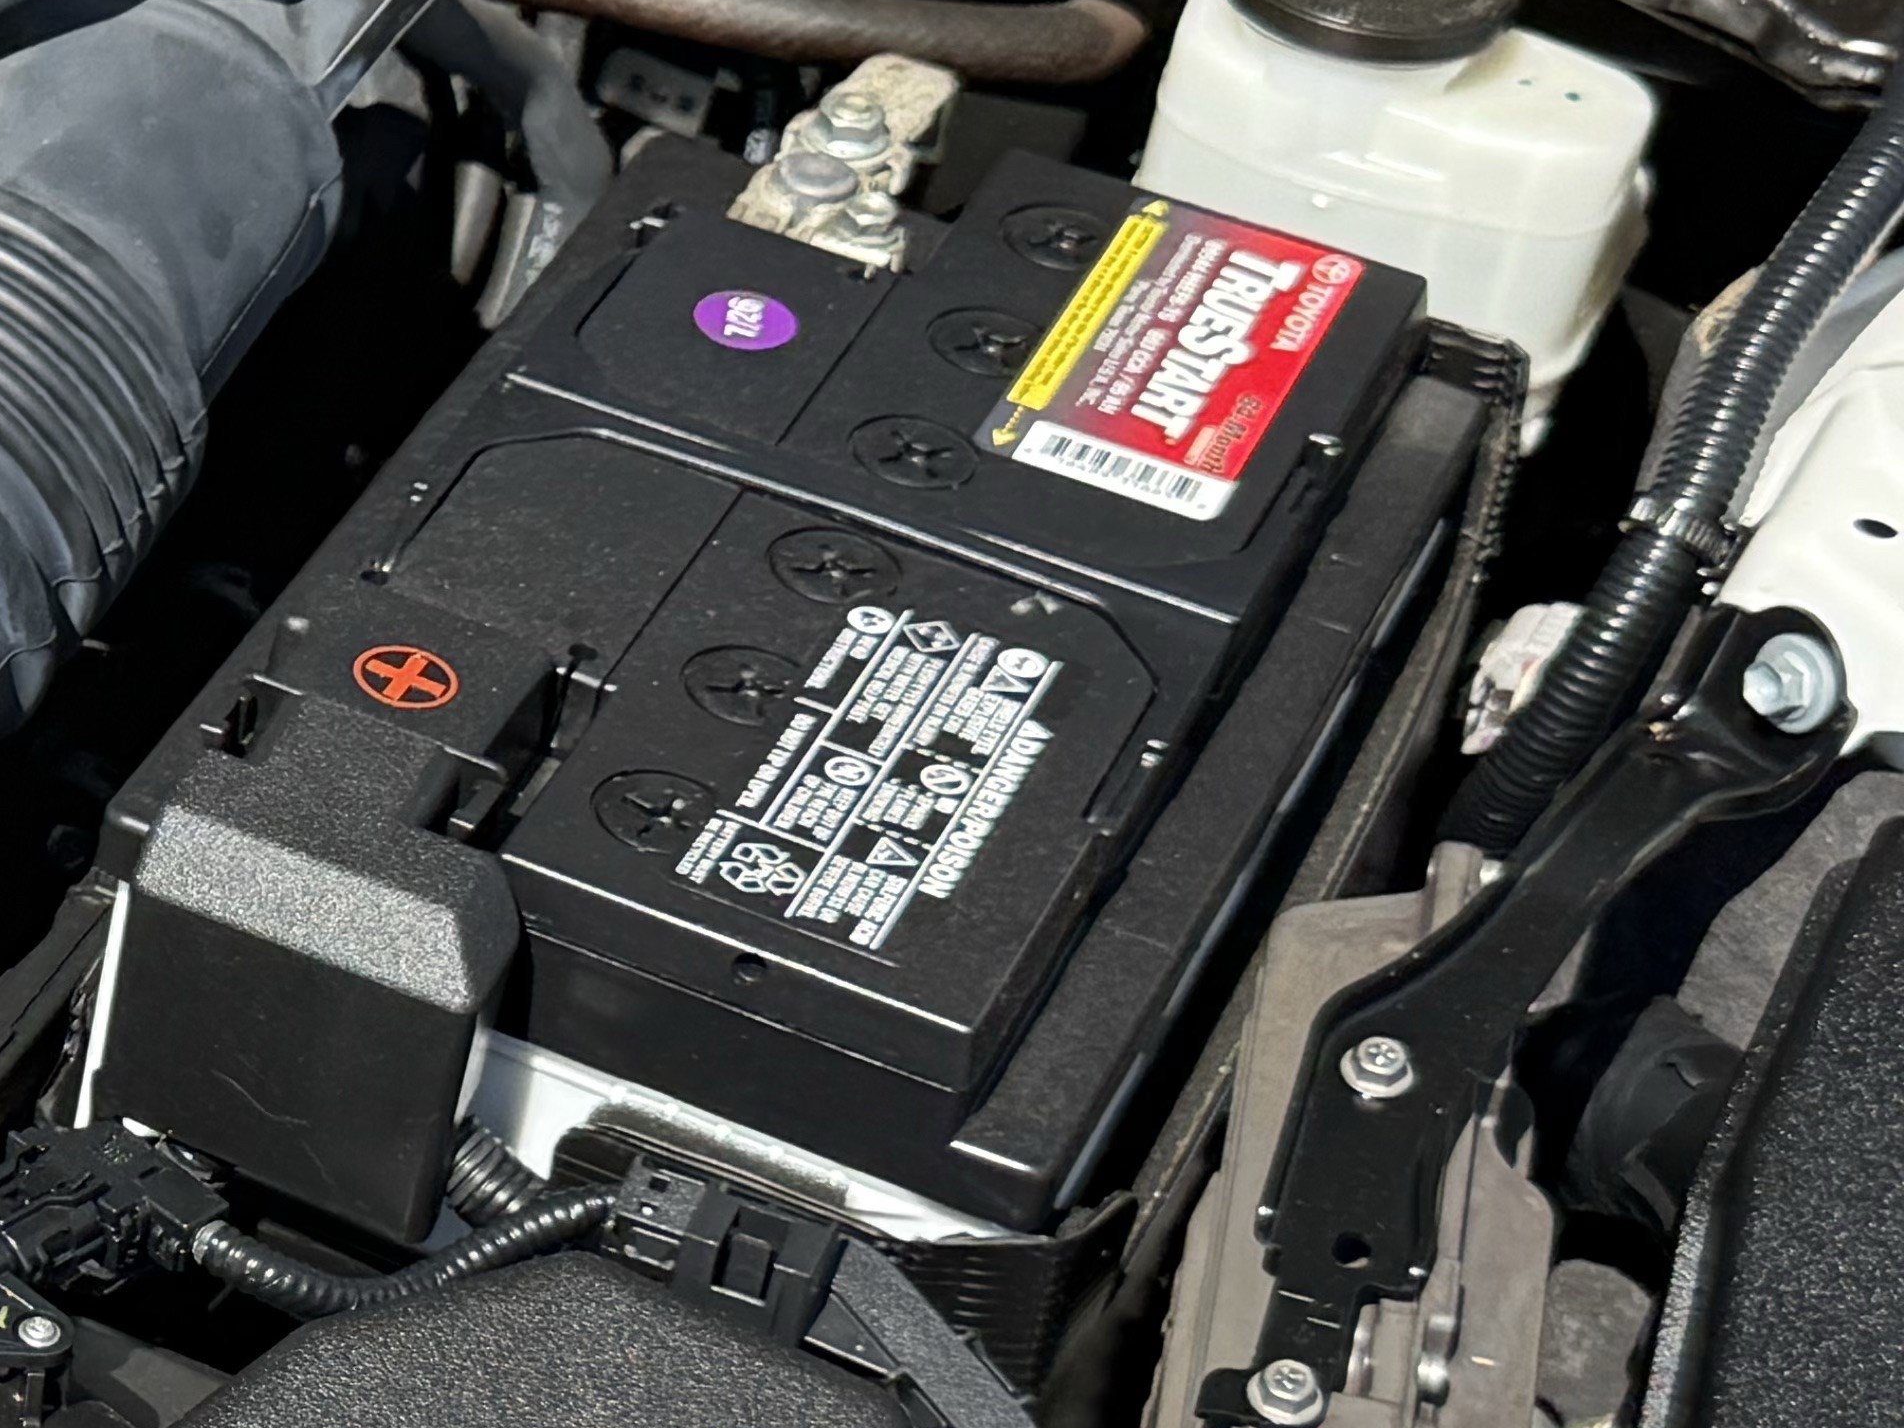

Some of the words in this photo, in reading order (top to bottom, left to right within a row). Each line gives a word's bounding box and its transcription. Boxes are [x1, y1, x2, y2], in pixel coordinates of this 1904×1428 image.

[1270, 284, 1331, 352] TOYOTA
[1121, 348, 1154, 375] CCA
[919, 730, 1045, 899] DANGER/POISON
